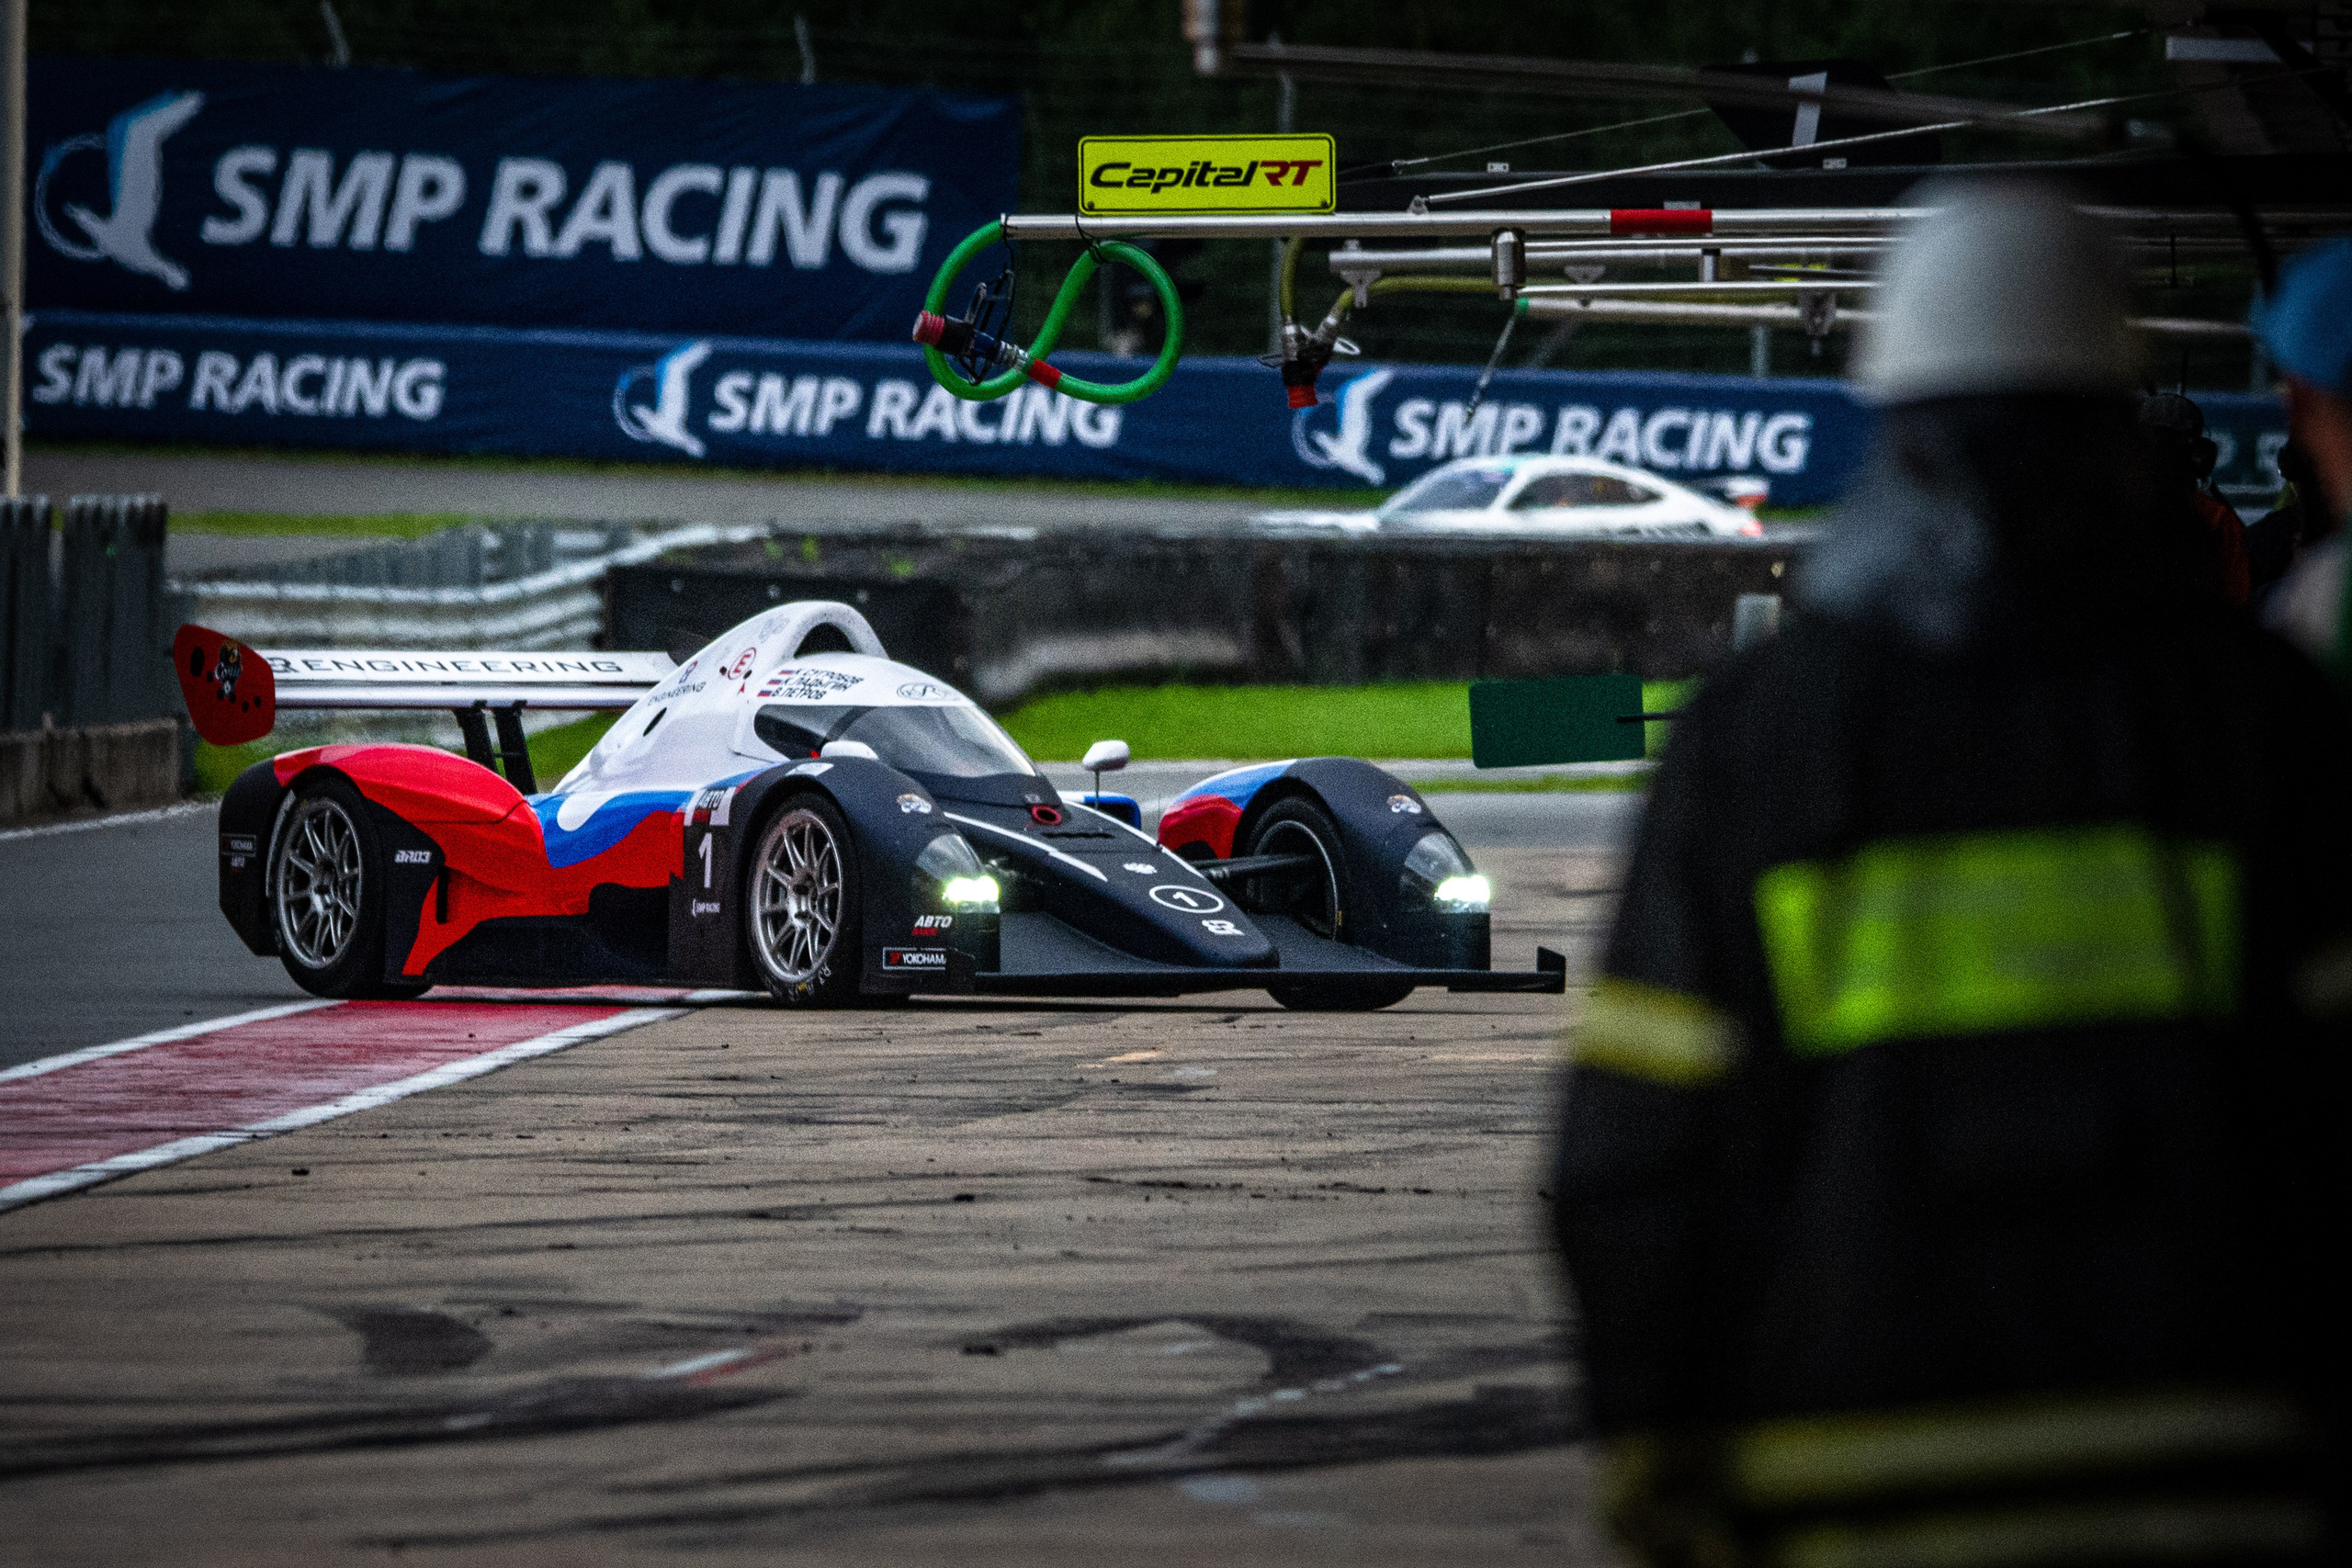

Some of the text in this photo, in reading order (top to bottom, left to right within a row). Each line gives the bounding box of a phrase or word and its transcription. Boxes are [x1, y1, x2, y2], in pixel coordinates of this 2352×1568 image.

[200, 144, 929, 273] SMP RACING
[33, 344, 447, 421] SMP RACING
[707, 371, 1123, 447] SMP RACING
[1388, 397, 1812, 474] SMP RACING
[300, 659, 625, 672] ENGINEERING
[698, 831, 712, 889] 1
[914, 915, 954, 928] АВТО
[1172, 891, 1199, 908] 1
